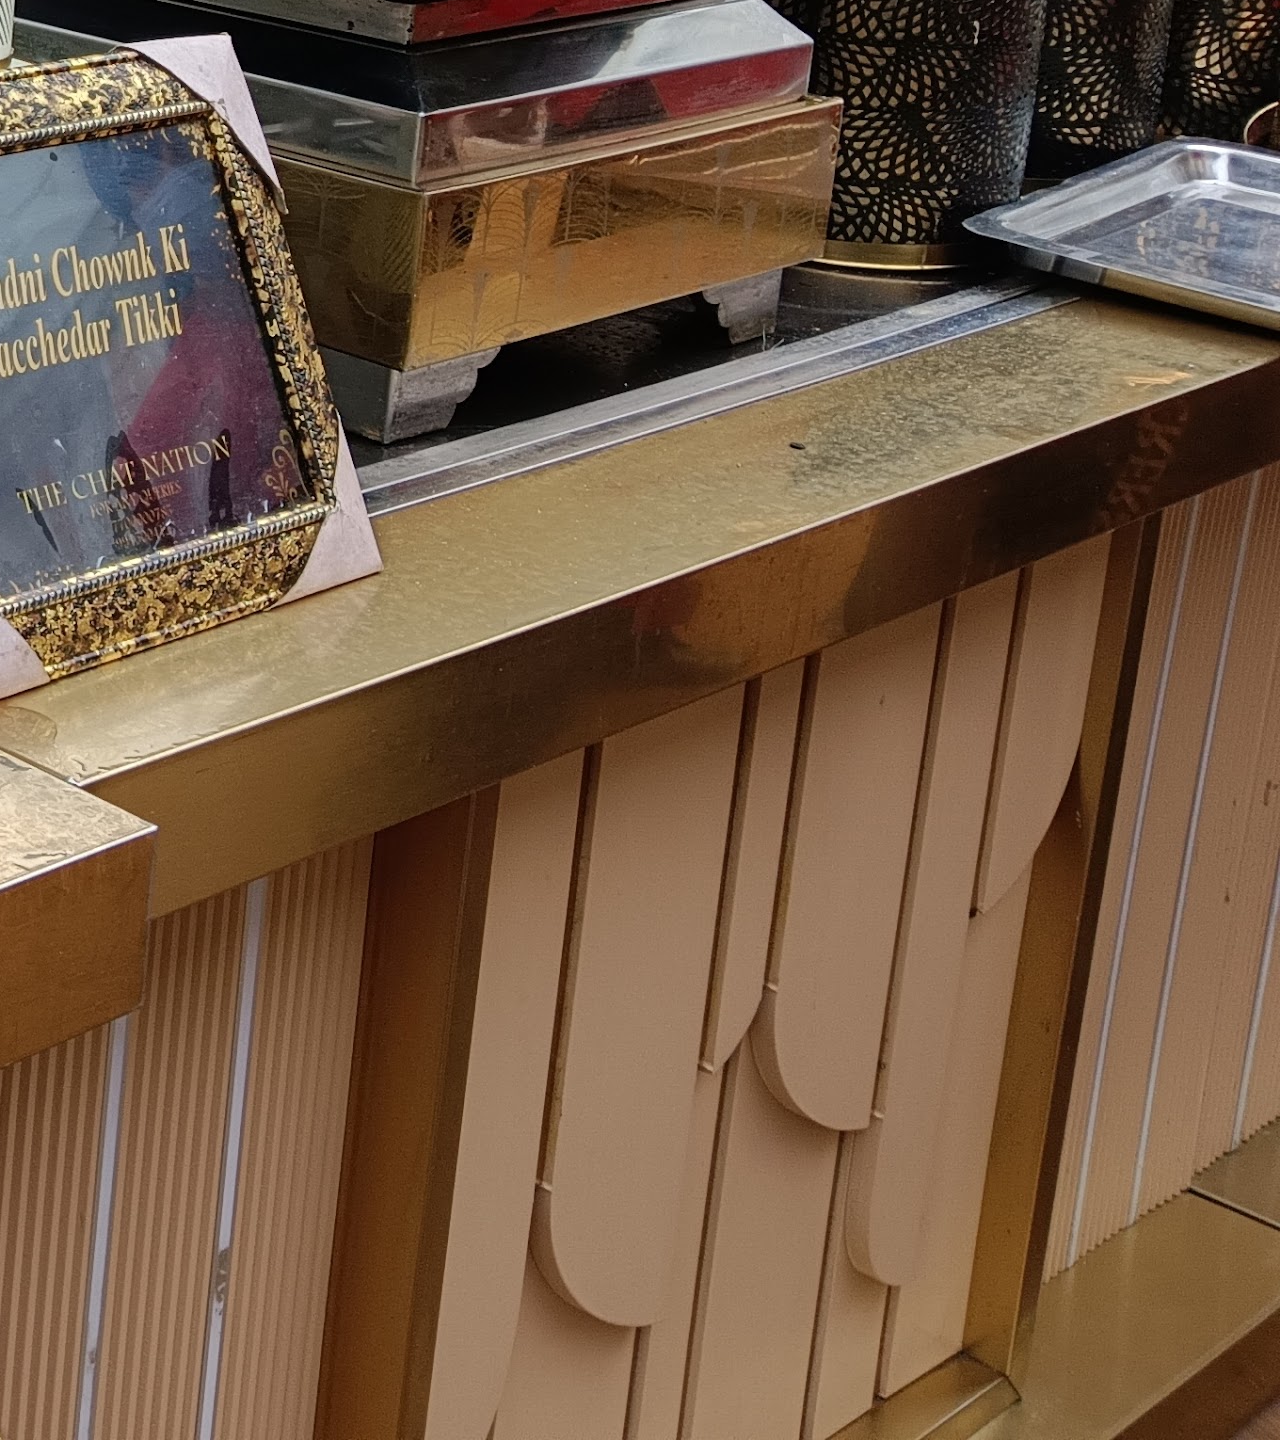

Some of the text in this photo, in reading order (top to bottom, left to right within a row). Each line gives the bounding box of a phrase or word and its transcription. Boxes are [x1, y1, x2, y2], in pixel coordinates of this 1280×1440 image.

[51, 231, 157, 297] Chownk
[159, 223, 191, 274] Ki
[115, 288, 183, 347] Tikki
[16, 435, 231, 514] THE CHAT NATION
